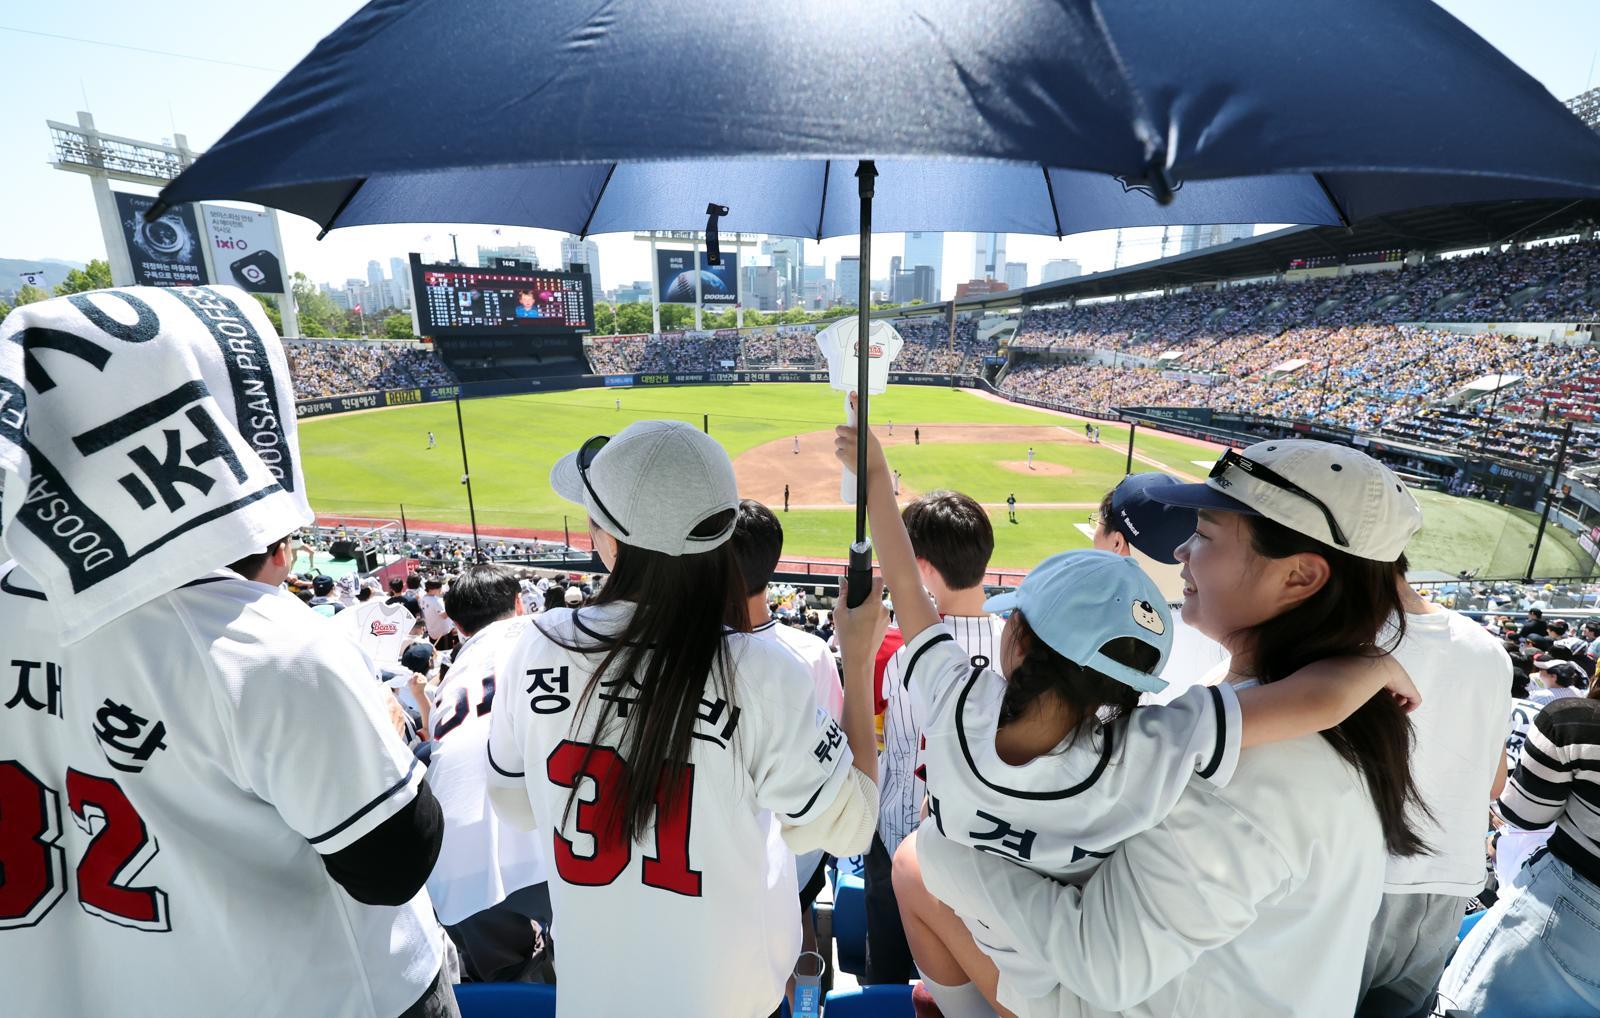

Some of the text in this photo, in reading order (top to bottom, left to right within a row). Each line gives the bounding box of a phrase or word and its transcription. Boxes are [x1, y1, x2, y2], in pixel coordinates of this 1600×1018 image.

[341, 395, 377, 410] 현대해상
[641, 374, 669, 384] 대방건설
[24, 473, 114, 572] DOOSA
[546, 738, 703, 898] 31
